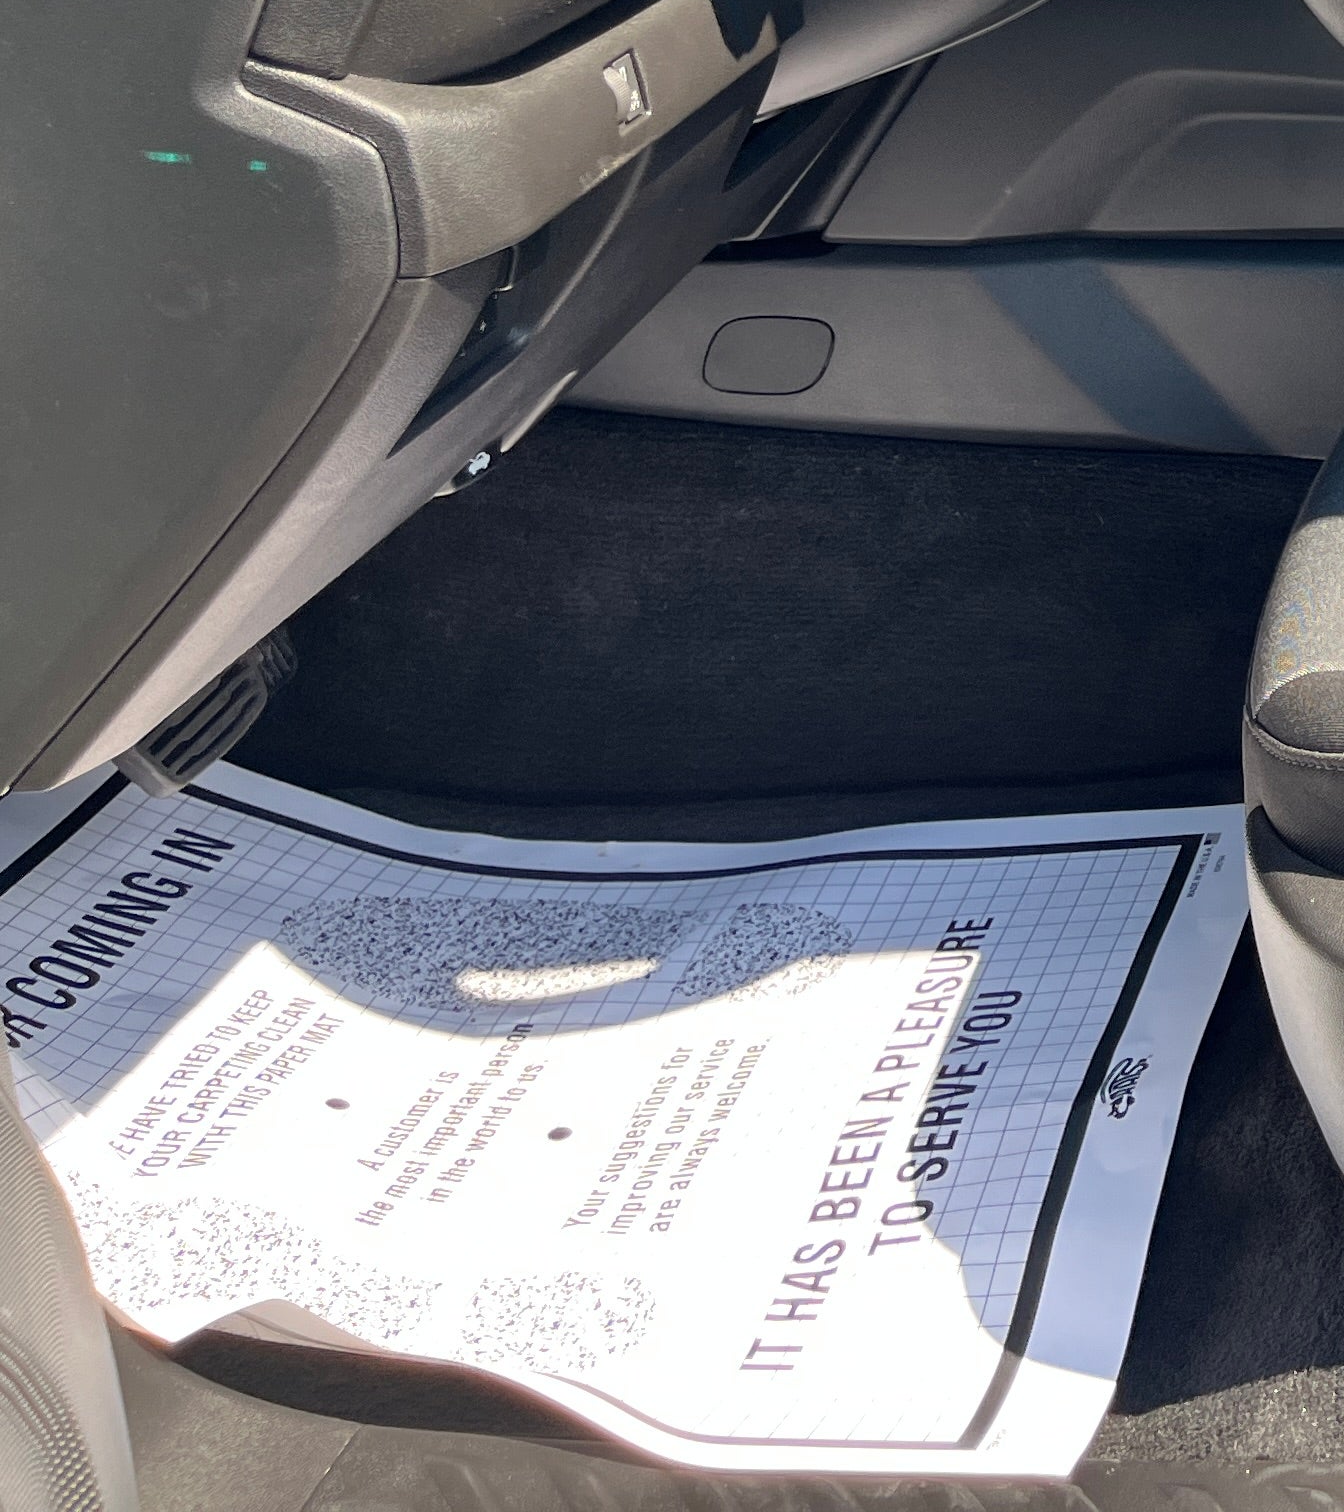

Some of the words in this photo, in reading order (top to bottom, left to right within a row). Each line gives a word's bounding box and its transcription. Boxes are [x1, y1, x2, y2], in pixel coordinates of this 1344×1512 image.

[6, 871, 193, 1009] COMING
[152, 828, 235, 873] IN
[873, 916, 995, 1074] PLEASURE
[956, 989, 1023, 1055] YOU
[119, 1095, 177, 1141] HAVE
[160, 1043, 220, 1090] TRIED
[205, 1025, 242, 1041] TO
[227, 989, 274, 1026] KEEP
[133, 1129, 192, 1177] YOUR
[177, 1042, 271, 1124] CARPETING
[256, 997, 316, 1042] CLEAN
[176, 1123, 237, 1169] WITH
[219, 1086, 272, 1119] THIS
[255, 1045, 316, 1085] PAPER
[299, 1013, 344, 1045] MAT
[355, 1201, 394, 1226] the
[384, 1160, 429, 1199] most
[412, 1081, 491, 1155] important
[481, 1023, 534, 1077] person
[357, 1158, 385, 1172] A
[374, 1088, 444, 1157] customer
[429, 1071, 459, 1084] is
[858, 1081, 911, 1102] A
[896, 1060, 990, 1182] SERVE
[420, 1187, 453, 1203] in
[437, 1157, 475, 1183] the
[465, 1106, 512, 1152] world
[497, 1087, 527, 1101] to
[561, 1189, 610, 1230] Your
[599, 1076, 678, 1183] suggestions
[660, 1047, 693, 1070] for
[601, 1141, 681, 1235] improving
[665, 1107, 695, 1135] our
[684, 1038, 736, 1100] service
[649, 1198, 681, 1232] are
[670, 1127, 720, 1191] always
[708, 1037, 772, 1122] welcome.
[809, 1116, 893, 1223] BEEN
[764, 1238, 847, 1322] HAS
[868, 1199, 934, 1256] TO
[739, 1338, 803, 1371] IT
